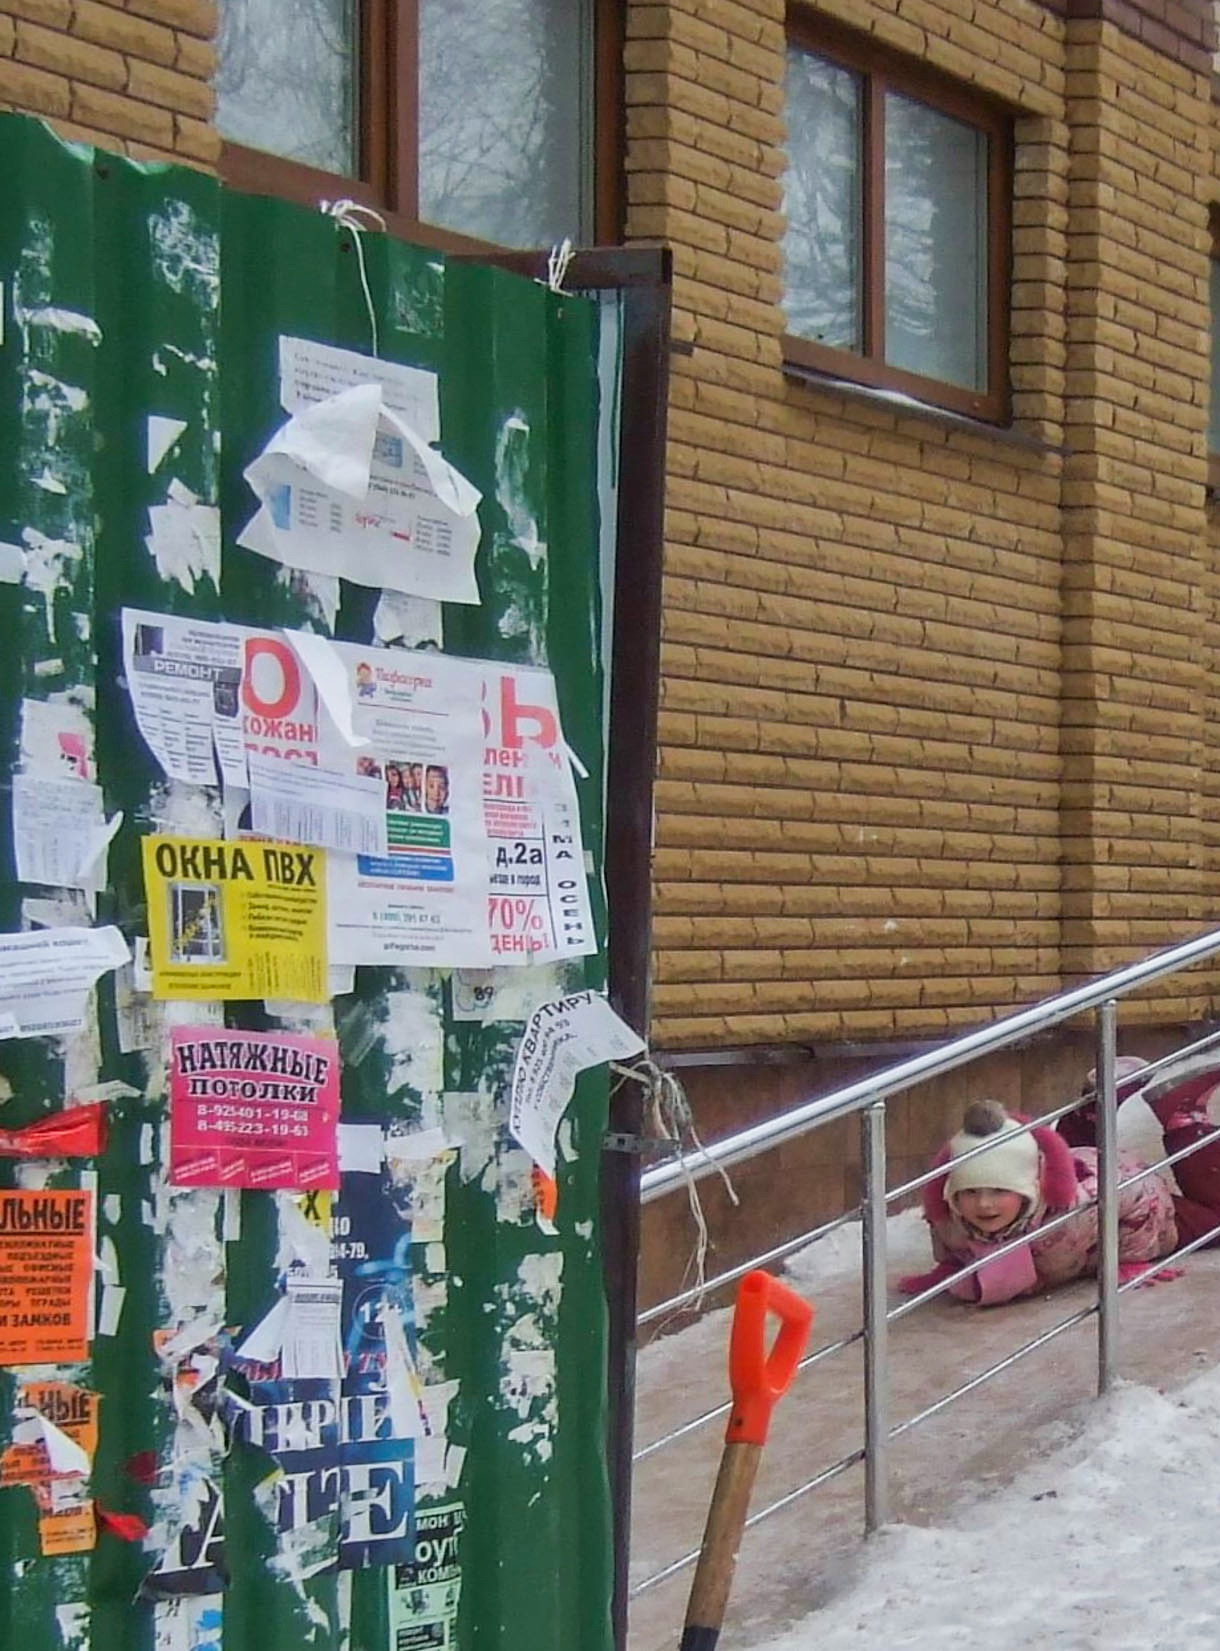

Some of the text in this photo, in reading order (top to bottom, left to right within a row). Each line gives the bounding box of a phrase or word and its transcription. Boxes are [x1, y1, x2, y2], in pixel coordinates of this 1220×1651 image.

[153, 659, 224, 682] РЕМОНТ
[243, 715, 318, 743] ожан
[155, 843, 254, 881] ОКНА
[263, 849, 317, 887] ПВХ
[487, 898, 544, 932] 70%
[176, 1041, 329, 1086] НАТЯЖНЫЕ
[189, 1077, 317, 1103] ПОТОЛКИ
